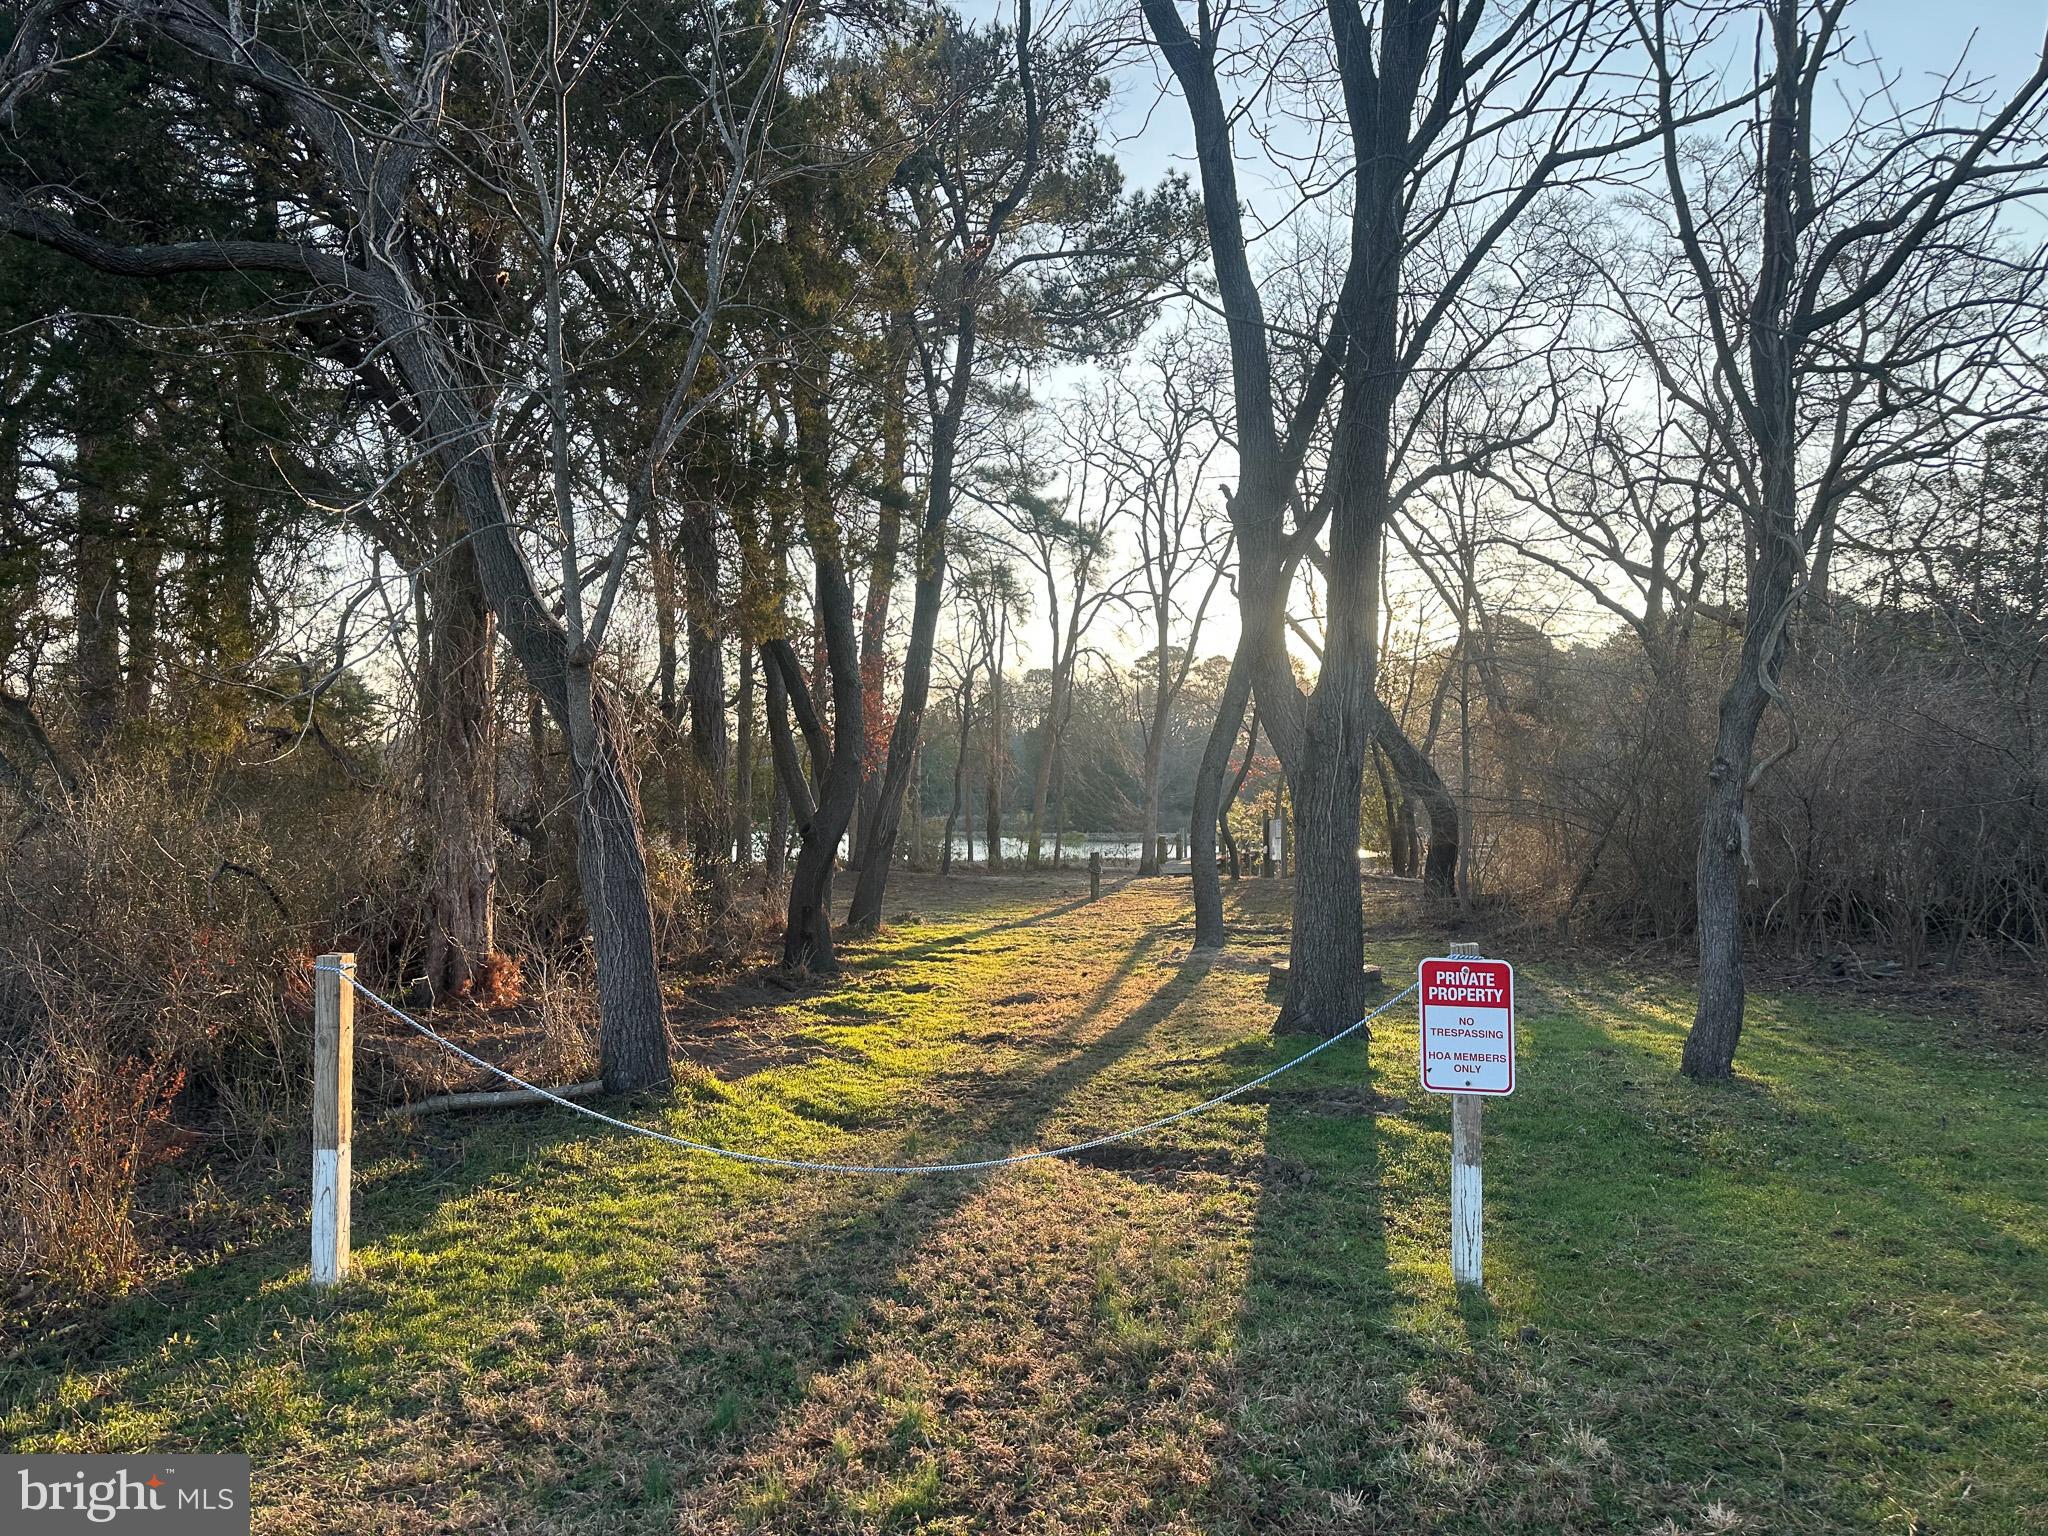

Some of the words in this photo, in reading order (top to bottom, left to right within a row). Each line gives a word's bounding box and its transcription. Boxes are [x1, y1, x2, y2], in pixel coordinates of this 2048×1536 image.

[1436, 971, 1495, 986] PRIVATE
[1429, 986, 1503, 1002] PROPERTY
[1459, 1017, 1474, 1025] NO
[1430, 1028, 1504, 1039] TRESPASSING
[1428, 1051, 1451, 1060] HOA
[1454, 1052, 1507, 1063] MEMBERS
[1454, 1064, 1481, 1073] ONLY
